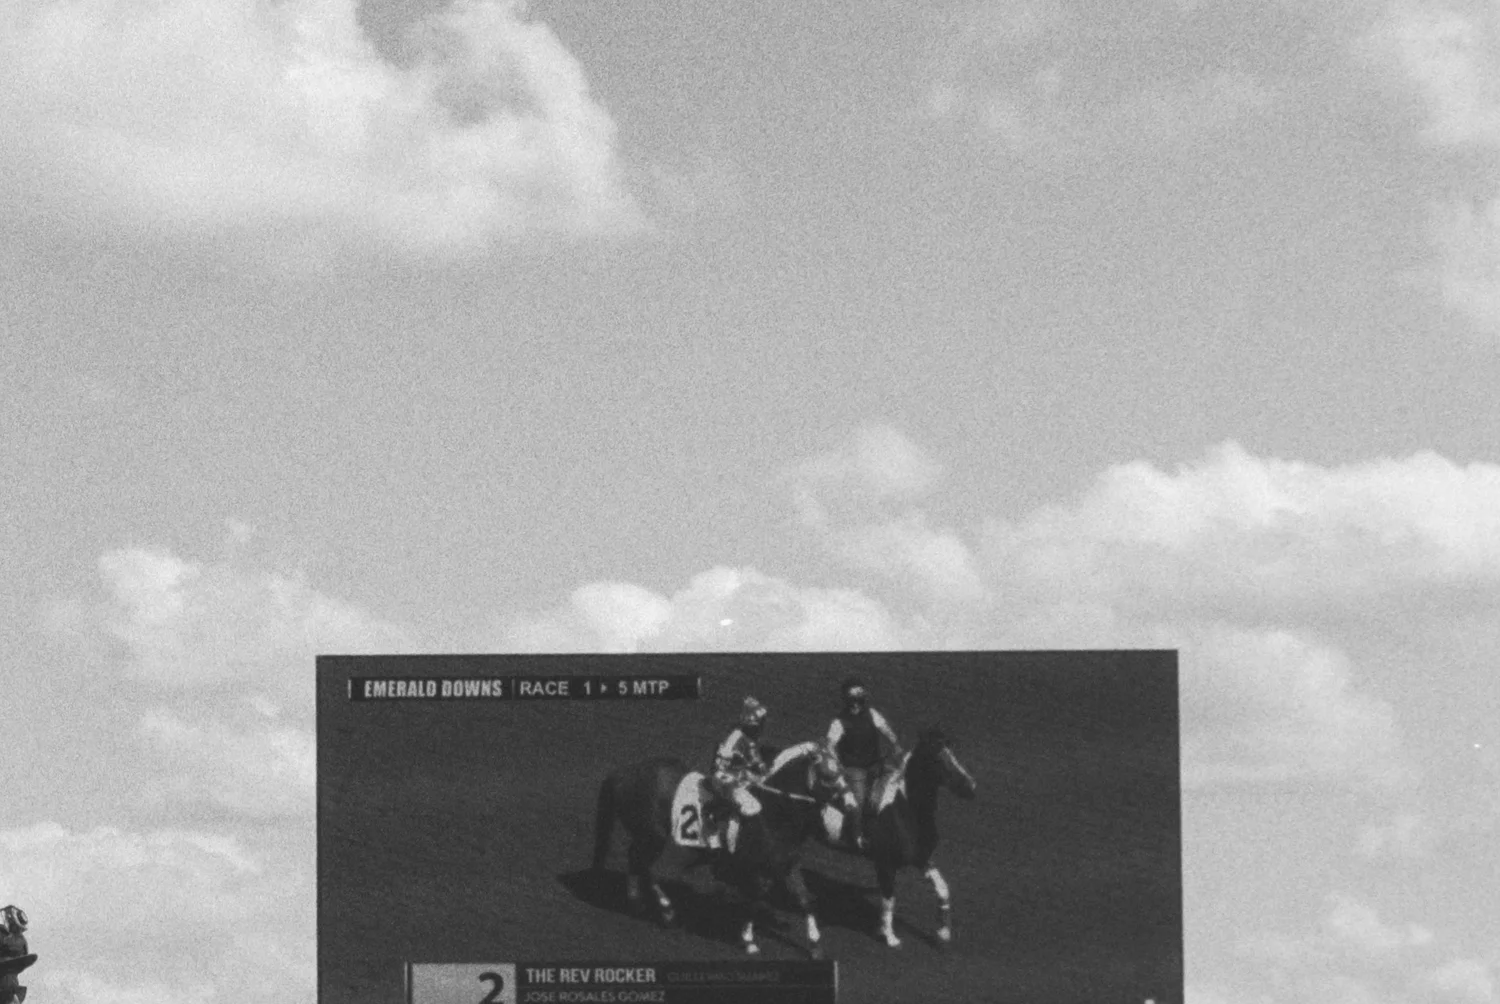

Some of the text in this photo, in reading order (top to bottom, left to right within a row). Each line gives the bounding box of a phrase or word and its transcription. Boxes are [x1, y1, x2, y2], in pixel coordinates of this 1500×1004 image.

[364, 679, 669, 697] EMERALD DOWNS RACE 1 5 MTP
[681, 804, 699, 837] 2
[526, 968, 656, 983] THE REV ROCKER
[525, 990, 665, 1003] JOSE ROSALES GOMEZ
